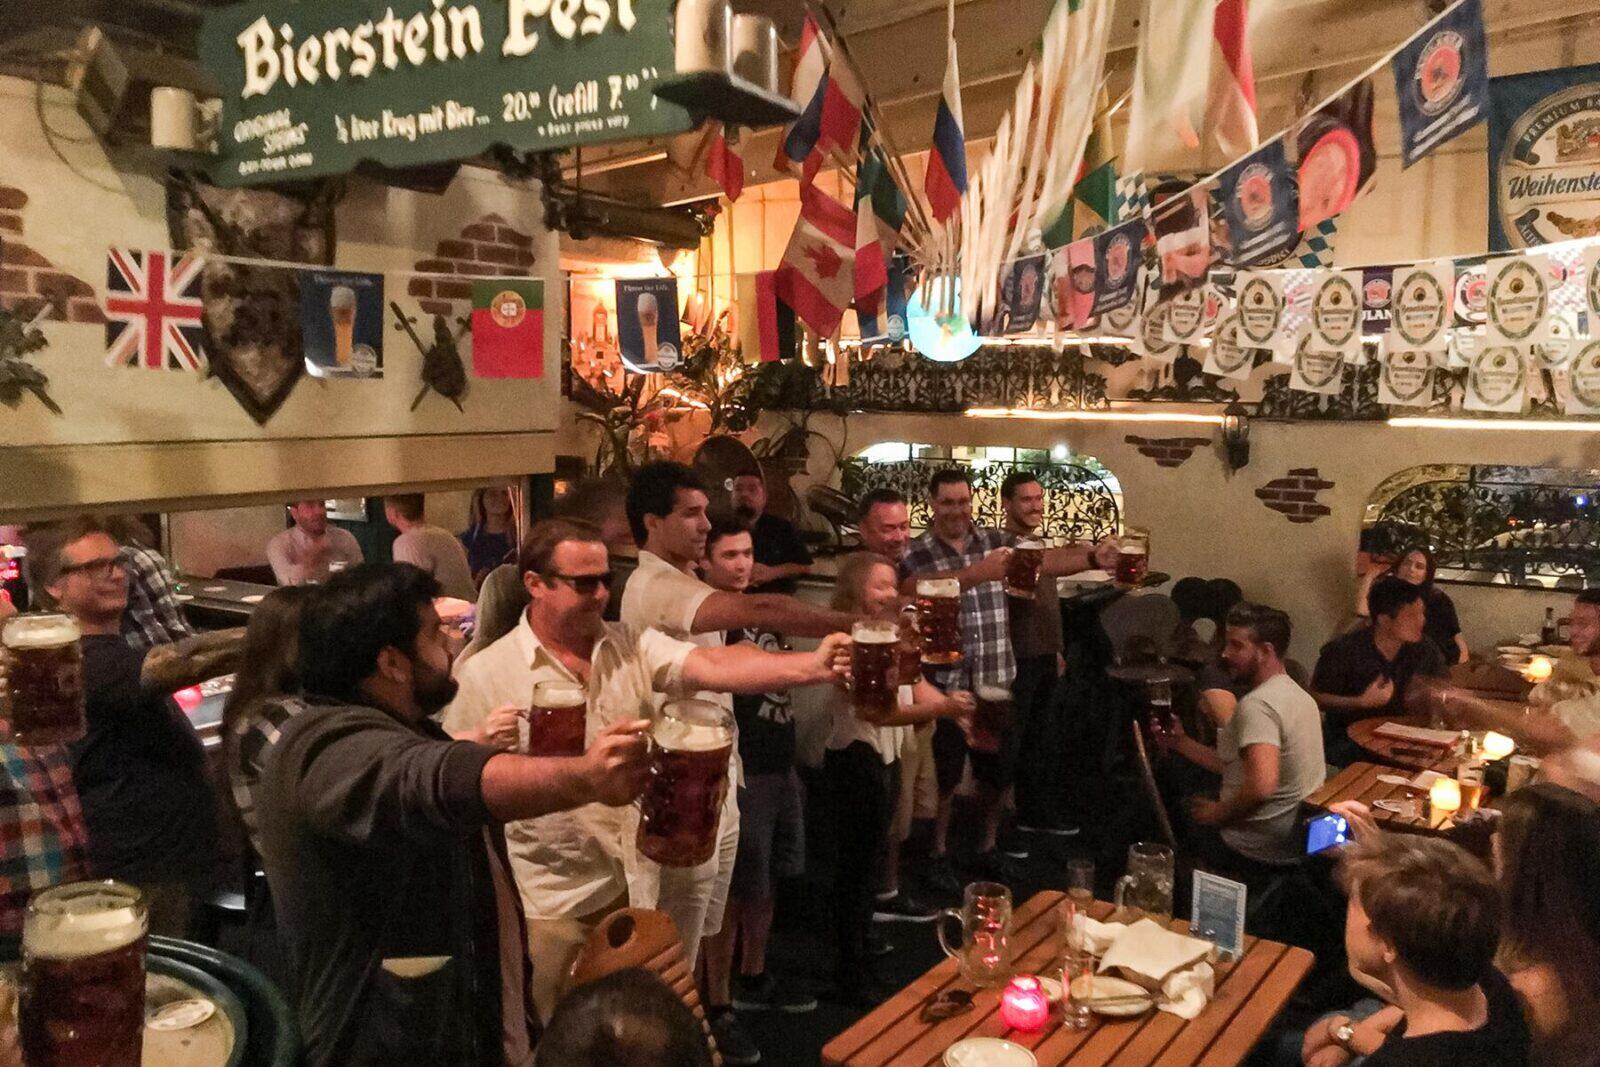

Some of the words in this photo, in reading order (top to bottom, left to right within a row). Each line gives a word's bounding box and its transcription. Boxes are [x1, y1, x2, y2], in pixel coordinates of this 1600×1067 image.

[236, 0, 484, 99] Bierstein
[549, 80, 599, 120] (refill
[1523, 101, 1580, 143] PREMIUM
[1508, 171, 1600, 199] Weihenste
